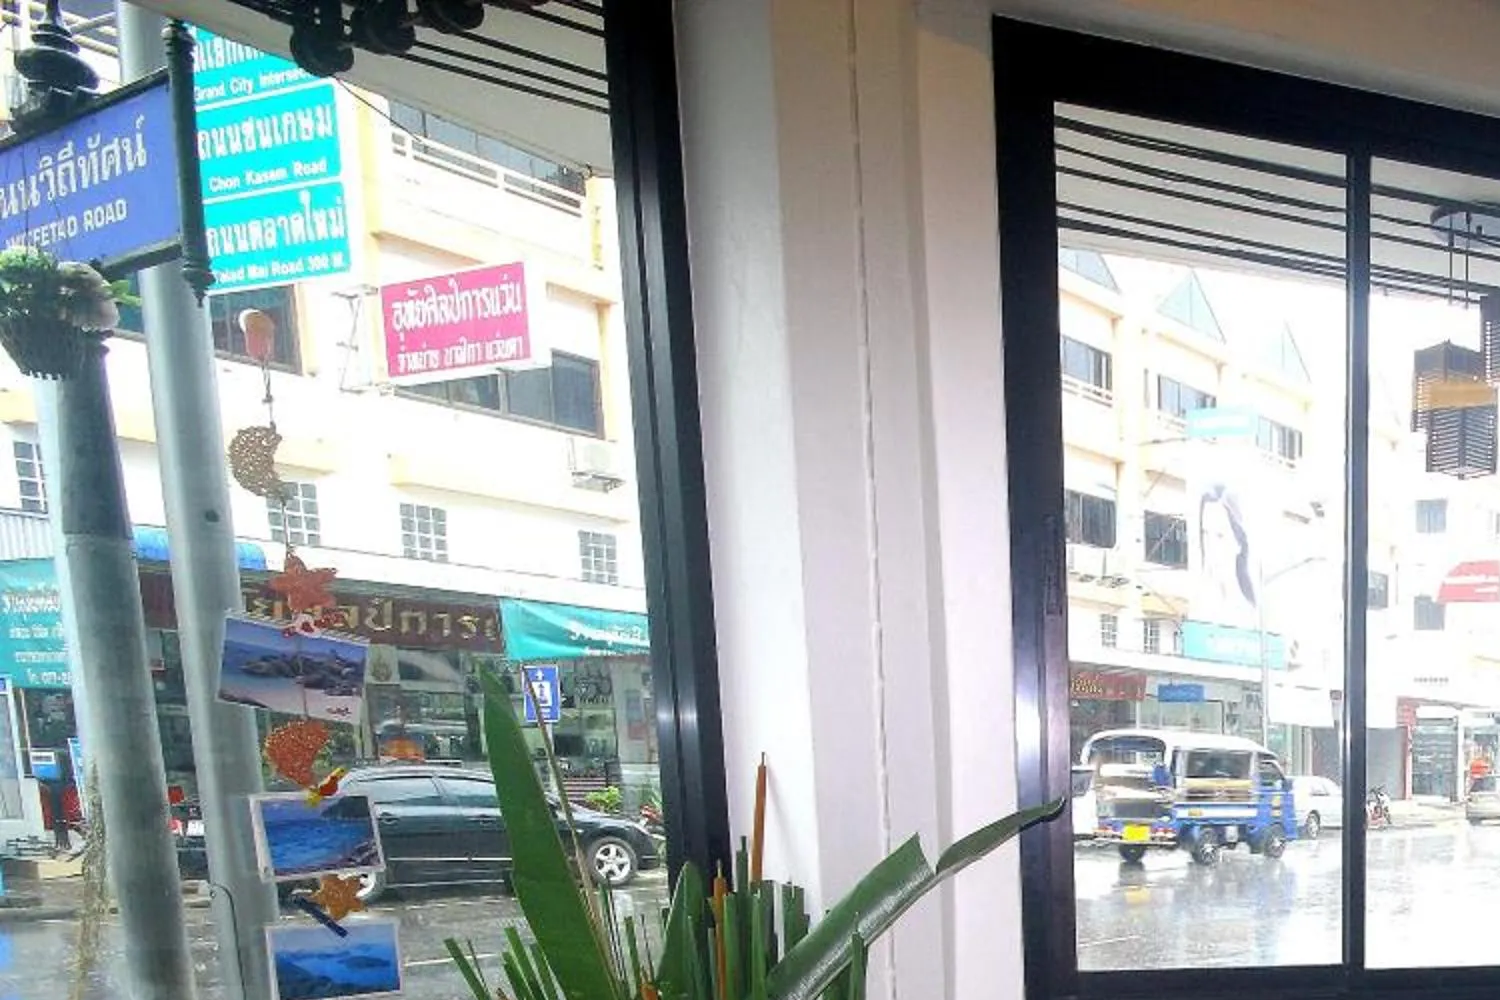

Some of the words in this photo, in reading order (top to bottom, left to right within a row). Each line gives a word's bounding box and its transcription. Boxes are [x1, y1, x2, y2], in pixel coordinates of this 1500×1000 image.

[229, 76, 254, 95] City
[0, 114, 148, 219] นนวิถีทัศน์
[292, 155, 328, 177] Road
[83, 198, 128, 233] ROAD
[271, 256, 305, 277] Road
